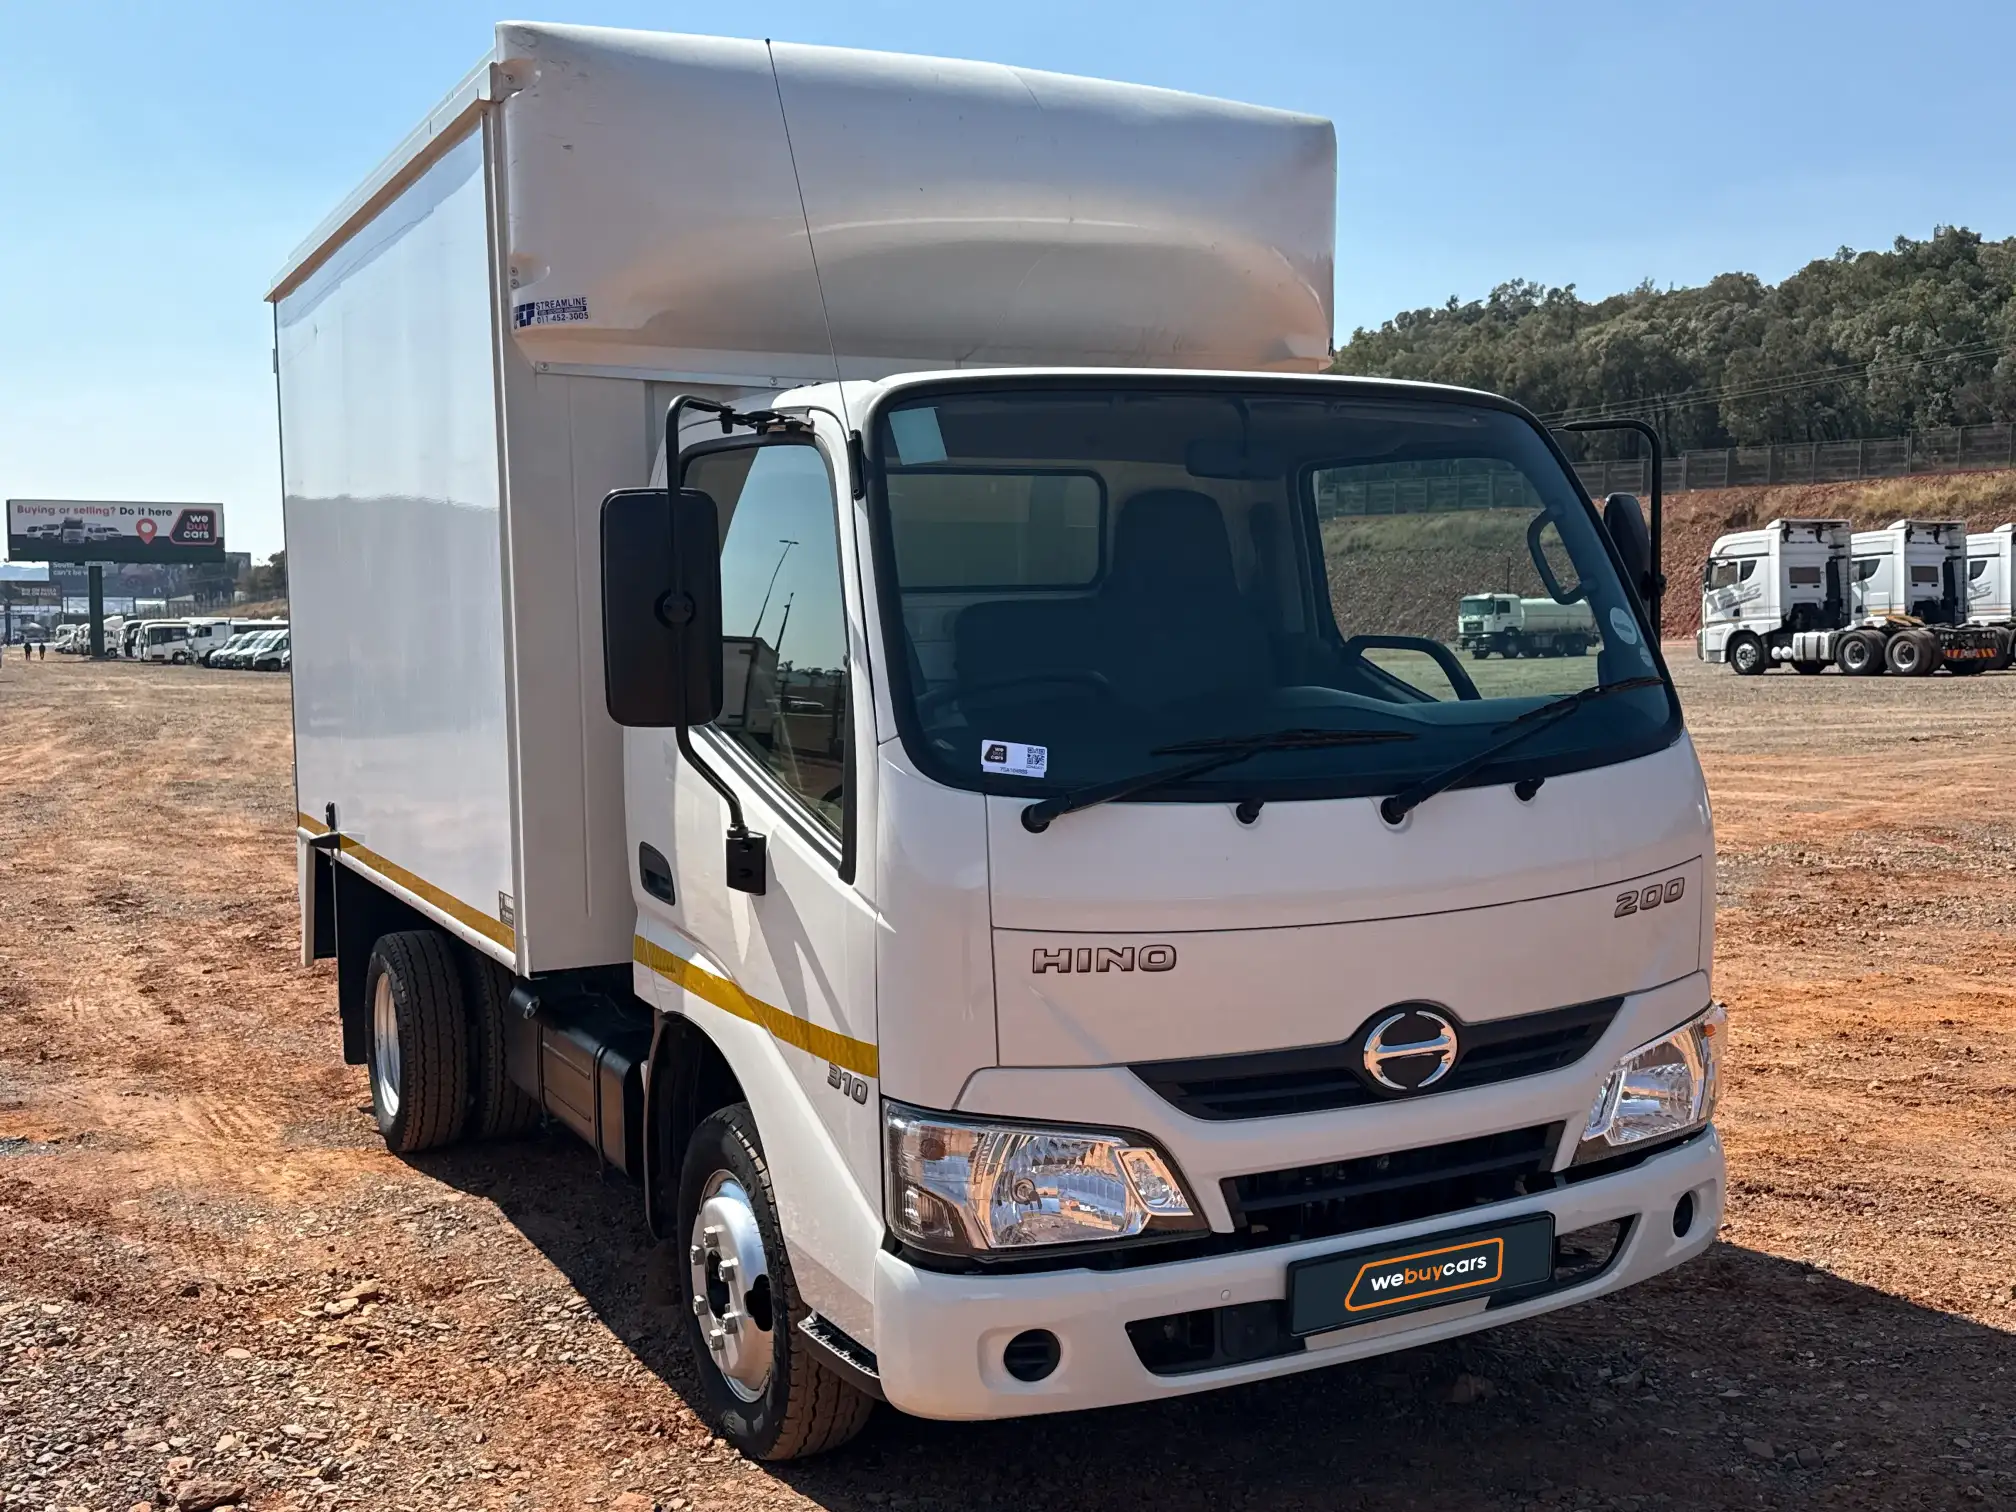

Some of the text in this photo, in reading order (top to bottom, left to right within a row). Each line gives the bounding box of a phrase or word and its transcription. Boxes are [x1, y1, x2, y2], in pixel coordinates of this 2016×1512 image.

[536, 297, 587, 310] STREAMLINE
[17, 505, 56, 516] Buying
[73, 506, 116, 517] selling?
[120, 507, 134, 515] Do
[138, 507, 145, 515] it
[148, 508, 172, 516] here
[190, 515, 208, 523] we
[183, 530, 209, 539] cars
[1614, 877, 1685, 918] 200
[1032, 944, 1177, 973] HINO
[827, 1061, 868, 1105] 310
[1371, 1256, 1487, 1291] webuycars
